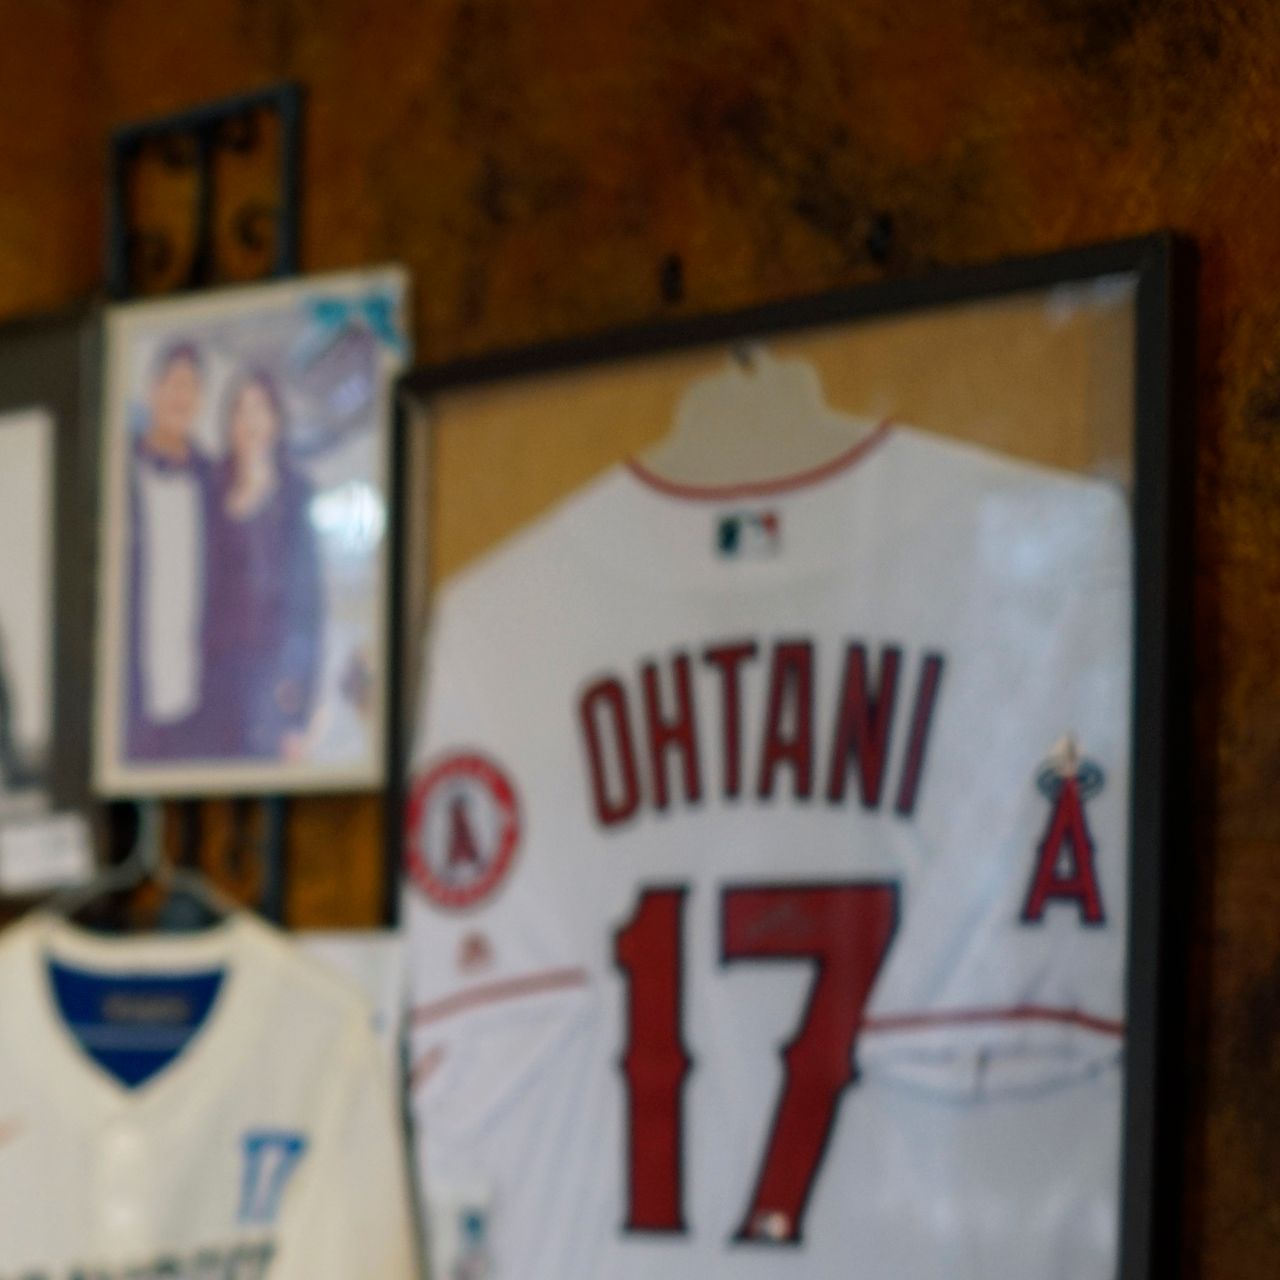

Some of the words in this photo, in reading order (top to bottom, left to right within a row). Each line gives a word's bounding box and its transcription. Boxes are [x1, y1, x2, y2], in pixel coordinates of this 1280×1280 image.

[577, 637, 945, 830] OHTANI
[1020, 774, 1107, 925] A
[613, 881, 901, 1246] 17
[242, 1131, 308, 1224] 17
